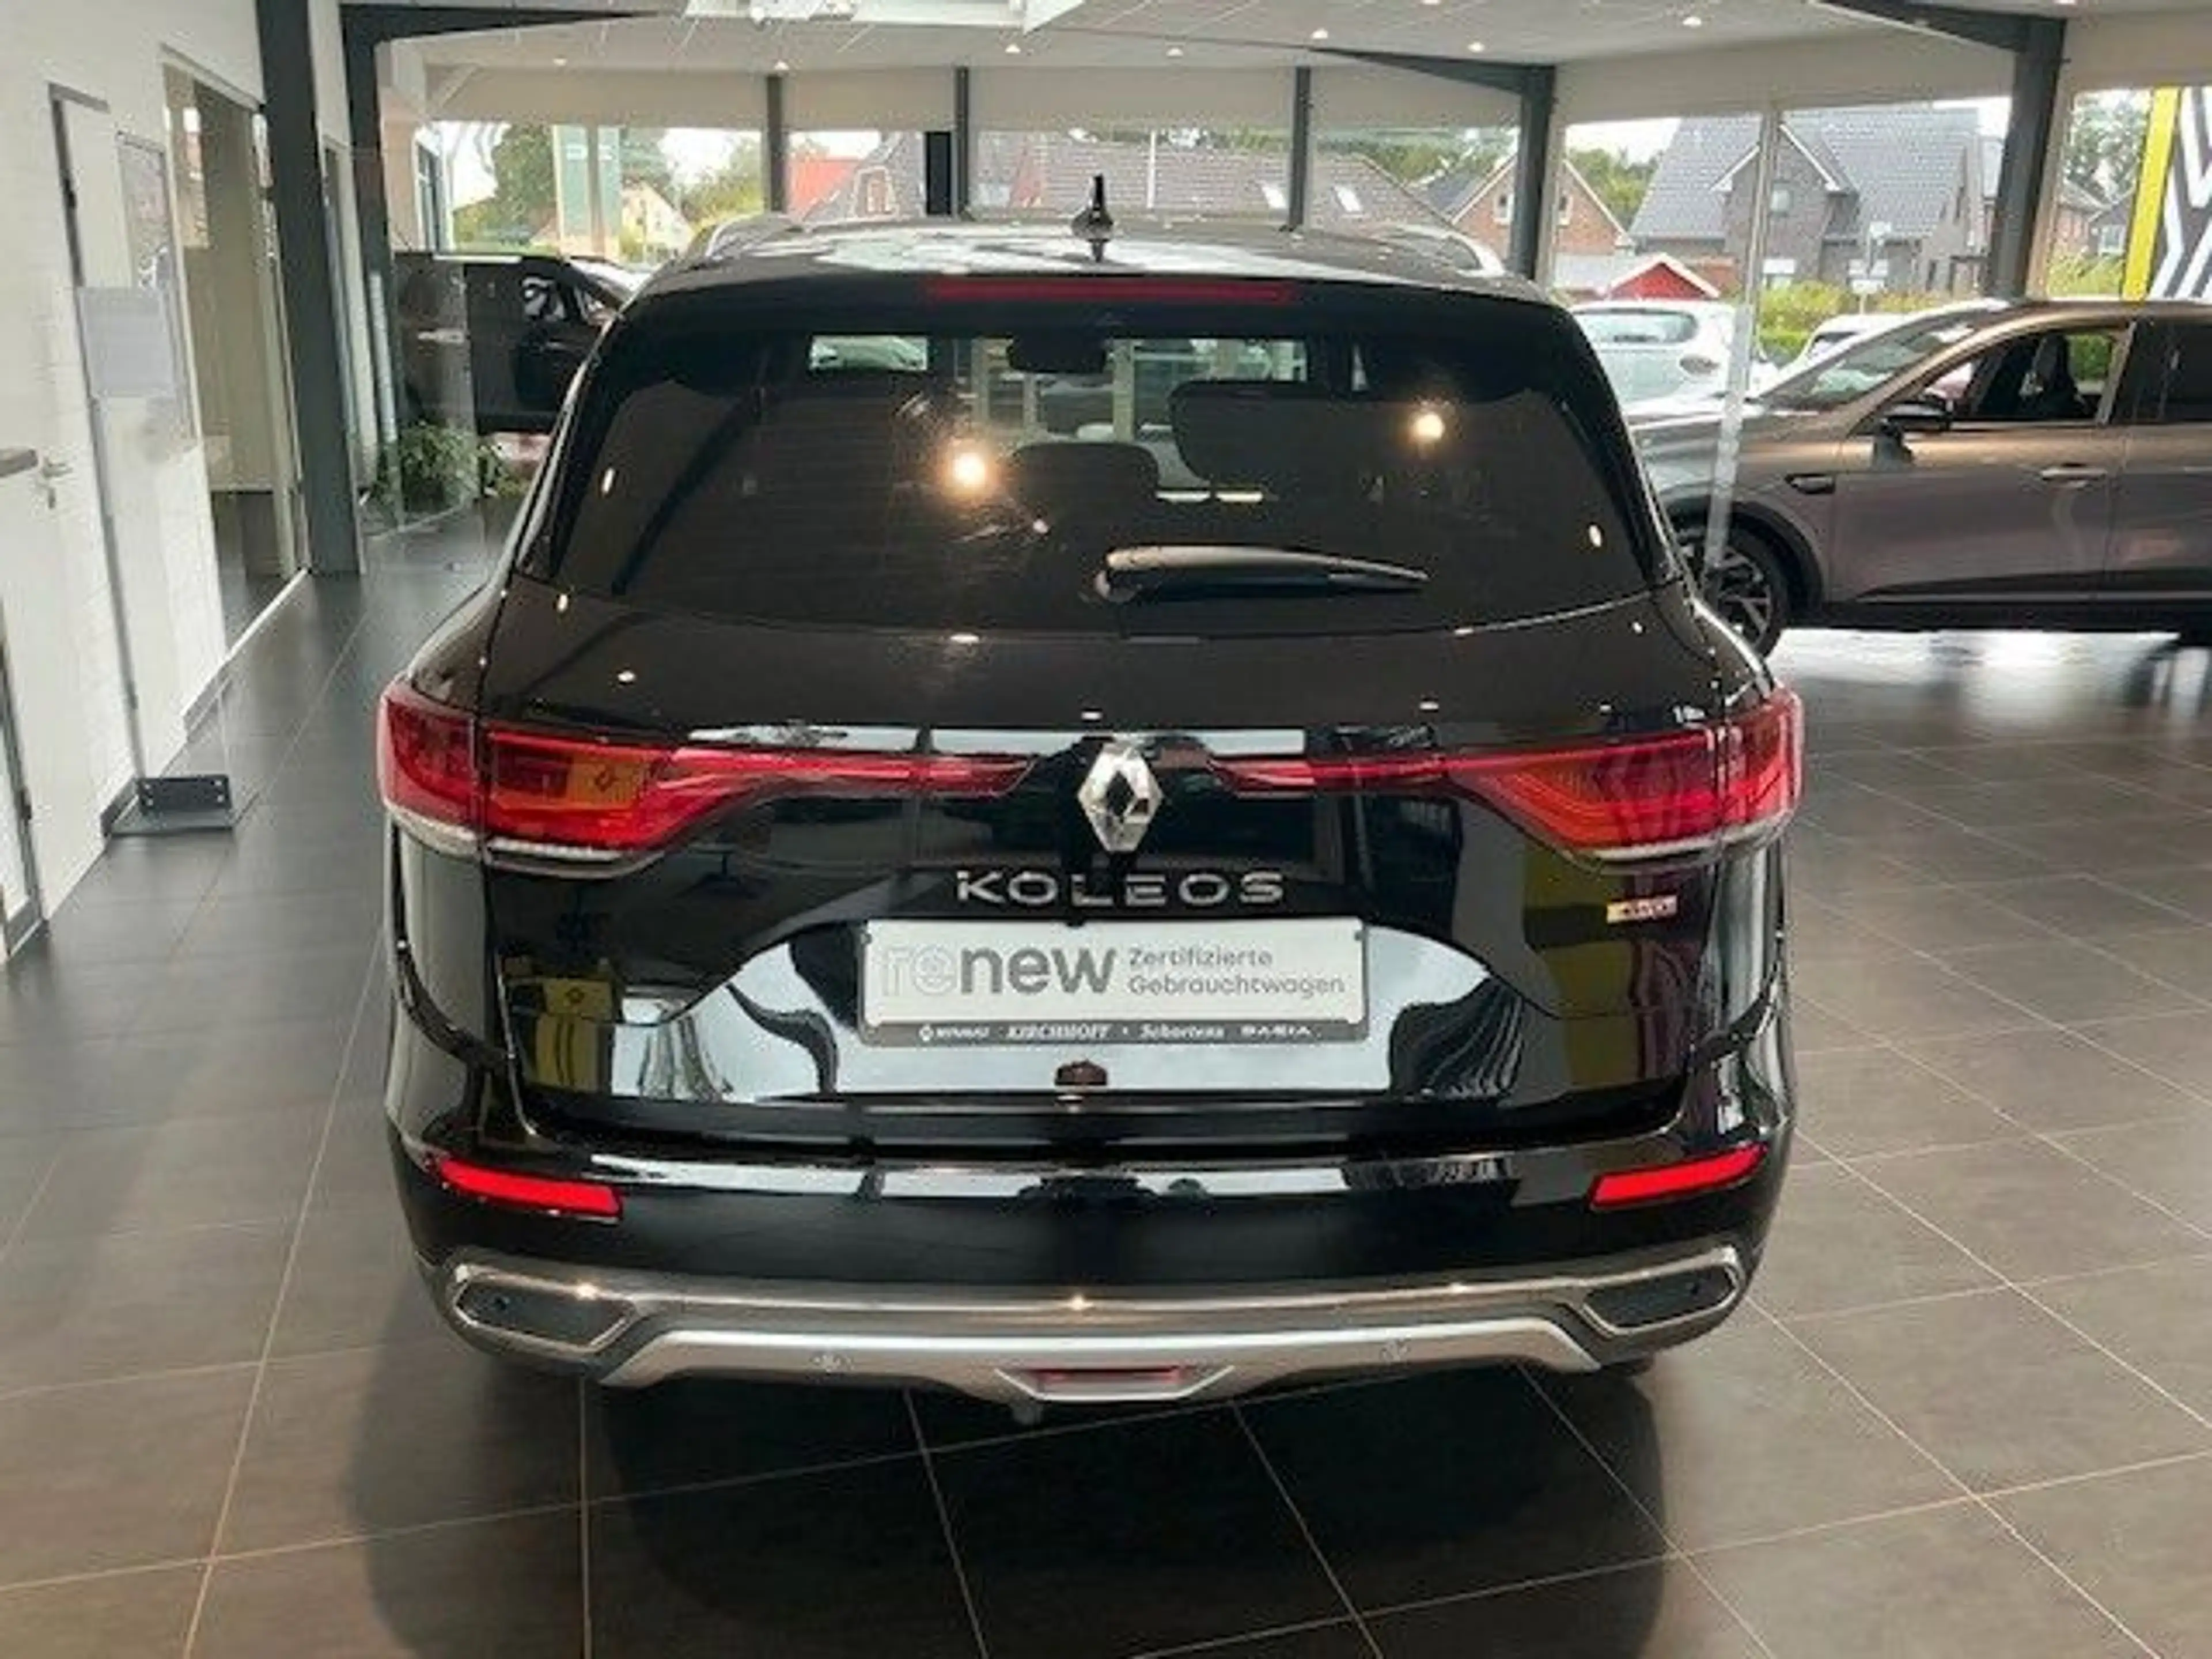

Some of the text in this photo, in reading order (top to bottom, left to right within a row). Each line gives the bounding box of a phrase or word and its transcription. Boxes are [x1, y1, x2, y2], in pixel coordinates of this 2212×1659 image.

[956, 870, 1285, 907] KOLEOS
[882, 946, 1117, 995] renew
[1128, 946, 1273, 967] Zertifizierte
[1128, 974, 1346, 998] Gebrauchtwagen
